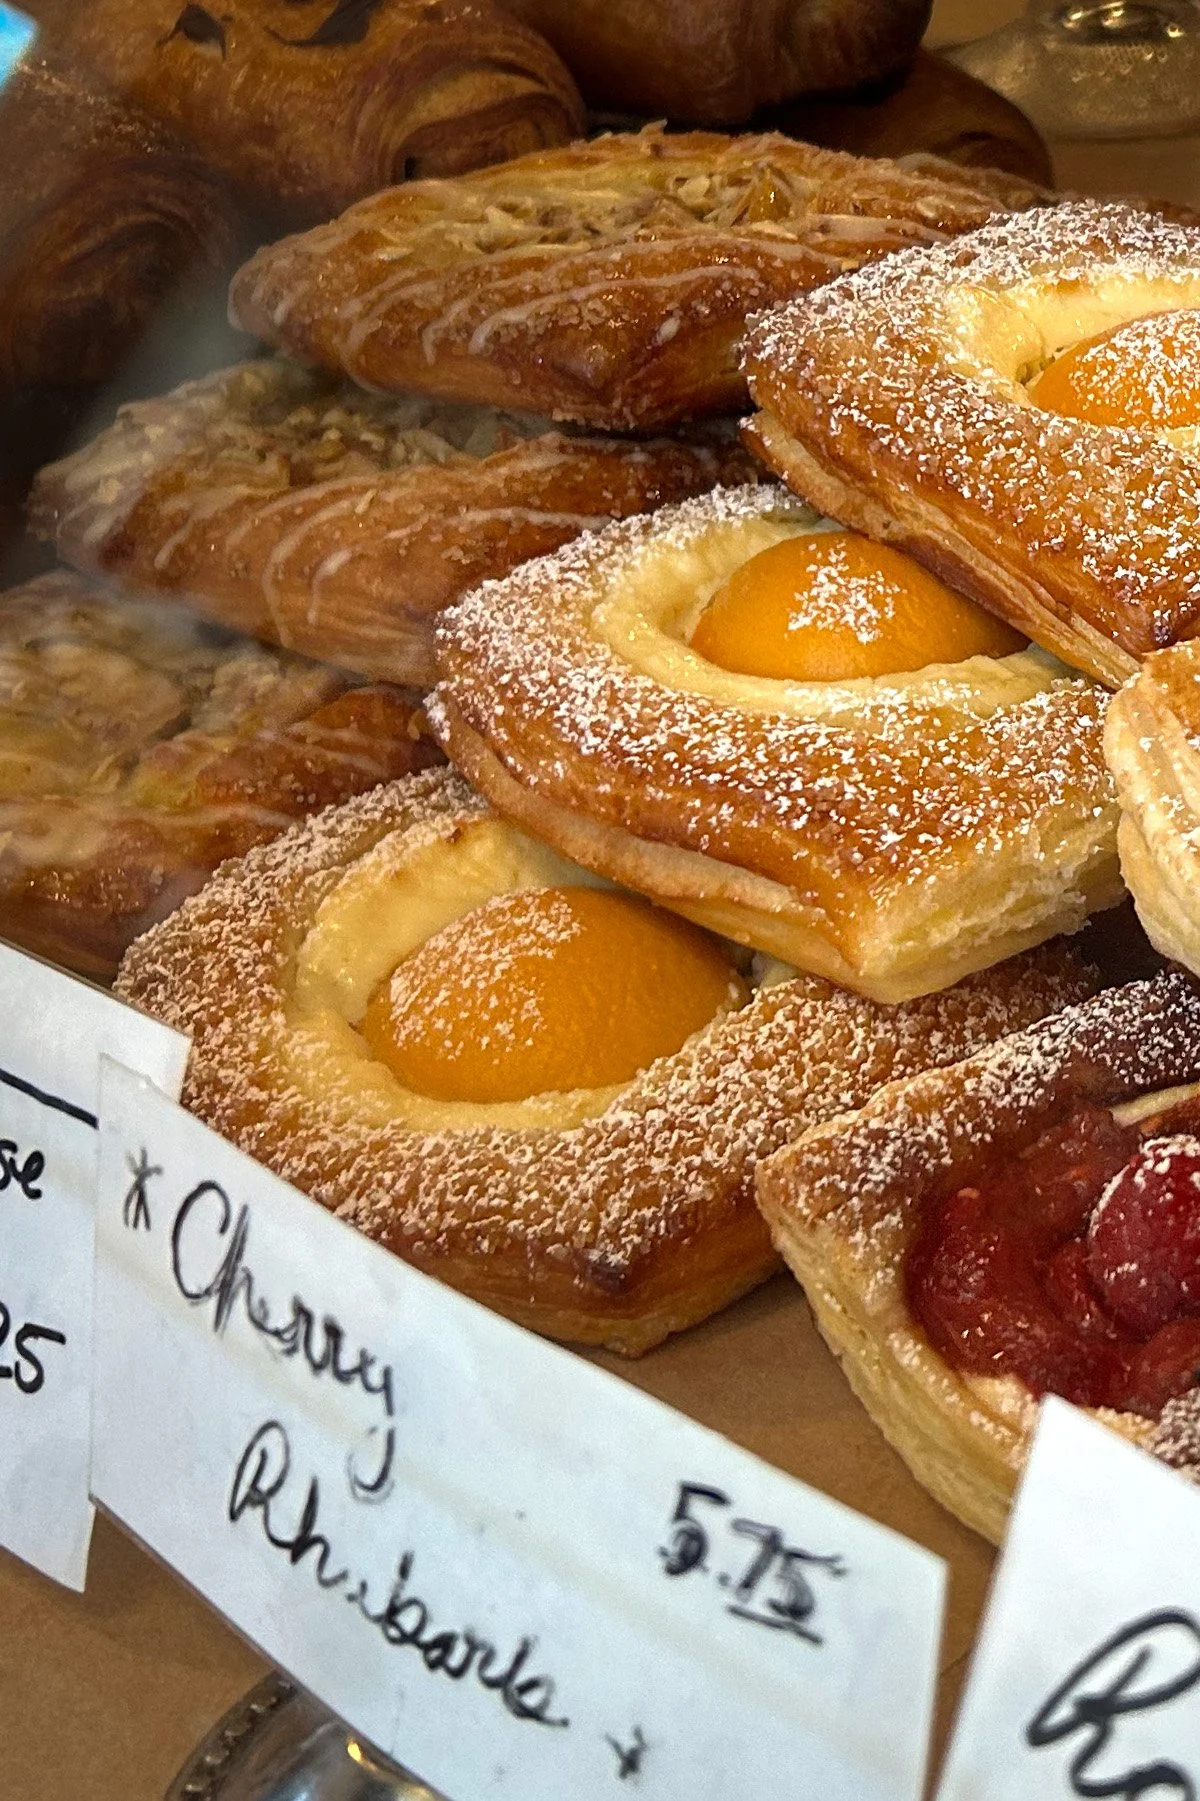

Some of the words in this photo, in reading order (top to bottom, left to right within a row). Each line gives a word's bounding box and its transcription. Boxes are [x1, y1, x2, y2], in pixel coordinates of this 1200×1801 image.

[171, 1179, 396, 1500] Cherry
[229, 1420, 570, 1728] Rhubarb
[657, 1480, 851, 1624] 5.75
